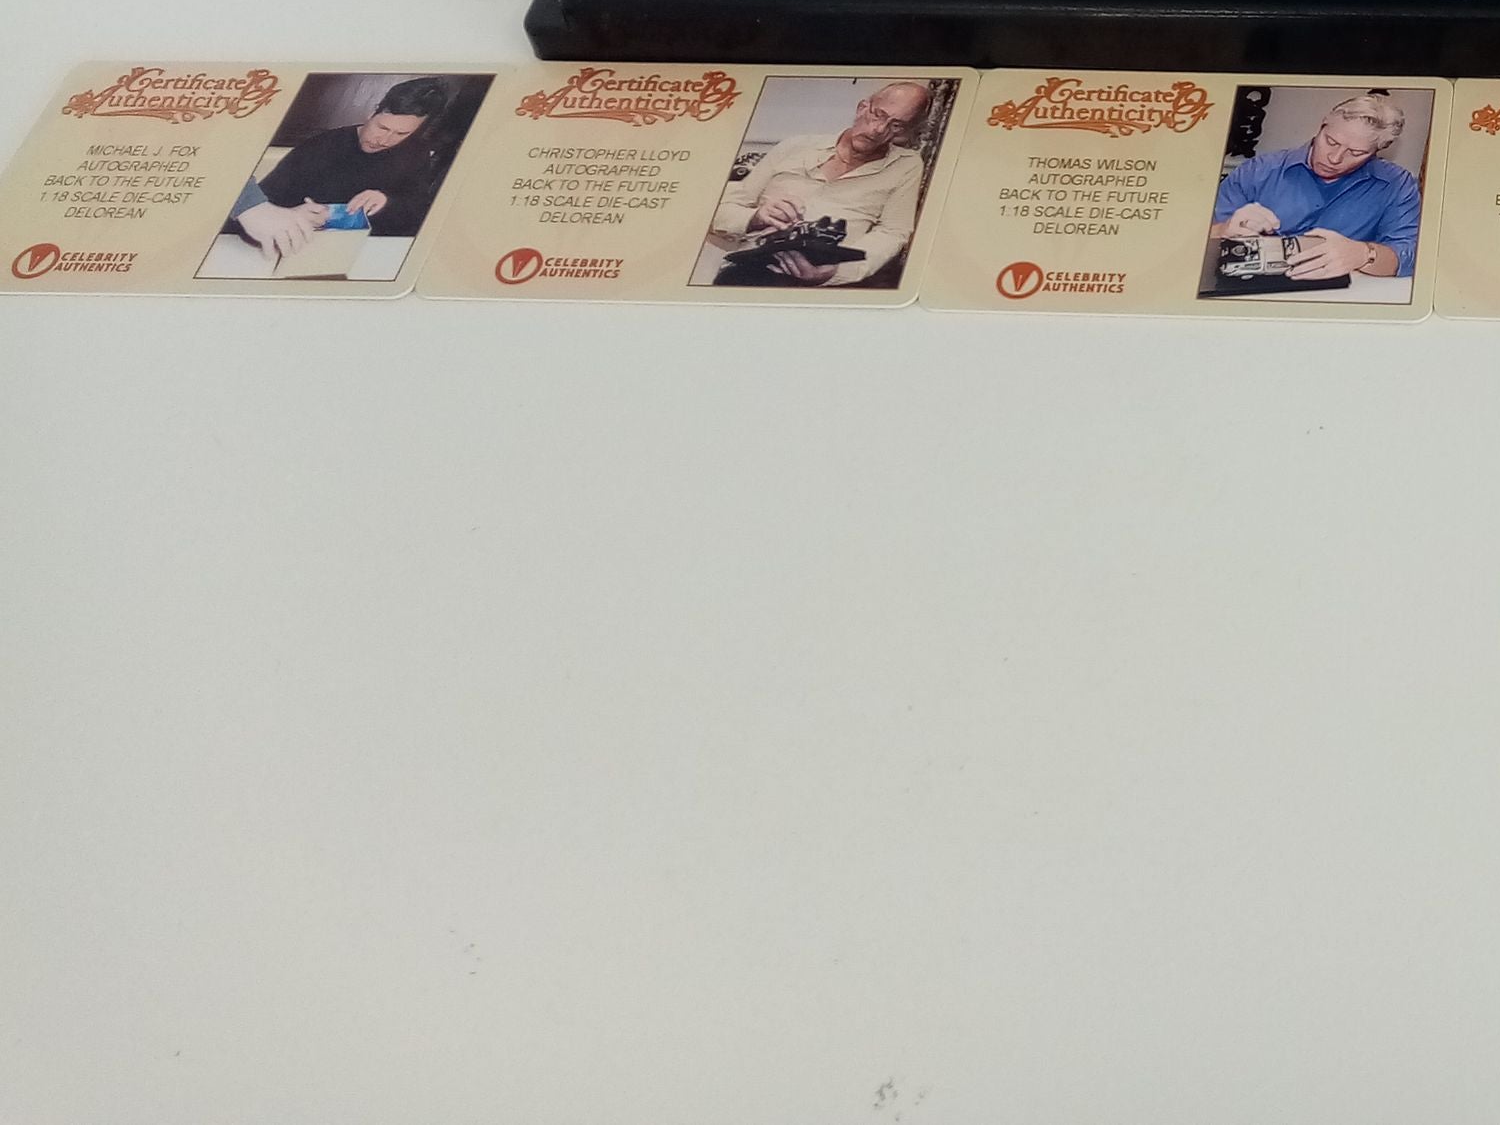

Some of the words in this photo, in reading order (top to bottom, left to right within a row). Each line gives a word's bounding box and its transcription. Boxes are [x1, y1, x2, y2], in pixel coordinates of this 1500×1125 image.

[125, 67, 247, 92] Certificate
[574, 68, 703, 93] Certificate
[1040, 78, 1174, 104] Certificate
[90, 85, 238, 119] Authenticity
[548, 88, 699, 121] Authenticity
[1019, 95, 1170, 130] Authenticity
[86, 146, 150, 156] MICHAEL
[169, 146, 200, 156] FOX
[528, 148, 638, 159] CHRISTOPHER
[641, 150, 690, 161] LLOYD
[77, 161, 189, 172] AUTOGRAPHED
[543, 164, 661, 176] AUTOGRAPHED
[1028, 157, 1091, 169] THOMAS
[1097, 160, 1156, 171] WILSON
[44, 176, 83, 186] BACK
[87, 176, 110, 186] TO
[113, 176, 140, 187] THE
[143, 177, 205, 188] FUTURE
[512, 179, 552, 189] BACK
[559, 180, 580, 190] TO
[584, 180, 614, 191] THE
[617, 181, 680, 193] FUTURE
[1029, 174, 1148, 187] AUTOGRAPHED
[71, 192, 118, 203] SCALE
[122, 193, 192, 203] DIE-CAST
[510, 196, 540, 206] 1:18
[543, 196, 594, 207] SCALE
[597, 197, 670, 209] DIE-CAST
[999, 189, 1041, 201] BACK
[1047, 190, 1067, 201] TO
[1073, 191, 1100, 202] THE
[1107, 191, 1169, 204] FUTURE
[64, 207, 148, 218] DELOREAN
[539, 212, 624, 223] DELOREAN
[1000, 206, 1030, 217] 1:18
[1033, 206, 1084, 218] SCALE
[1089, 207, 1163, 220] DIE-CAST
[1033, 223, 1119, 235] DELOREAN
[60, 253, 138, 261] CELEBRITY
[545, 258, 623, 268] CELEBRITY
[54, 263, 132, 272] AUTHENTICS
[539, 269, 620, 278] AUTHENTICS
[1046, 272, 1126, 282] CELEBRITY
[1043, 283, 1124, 293] AUTHENTICS
